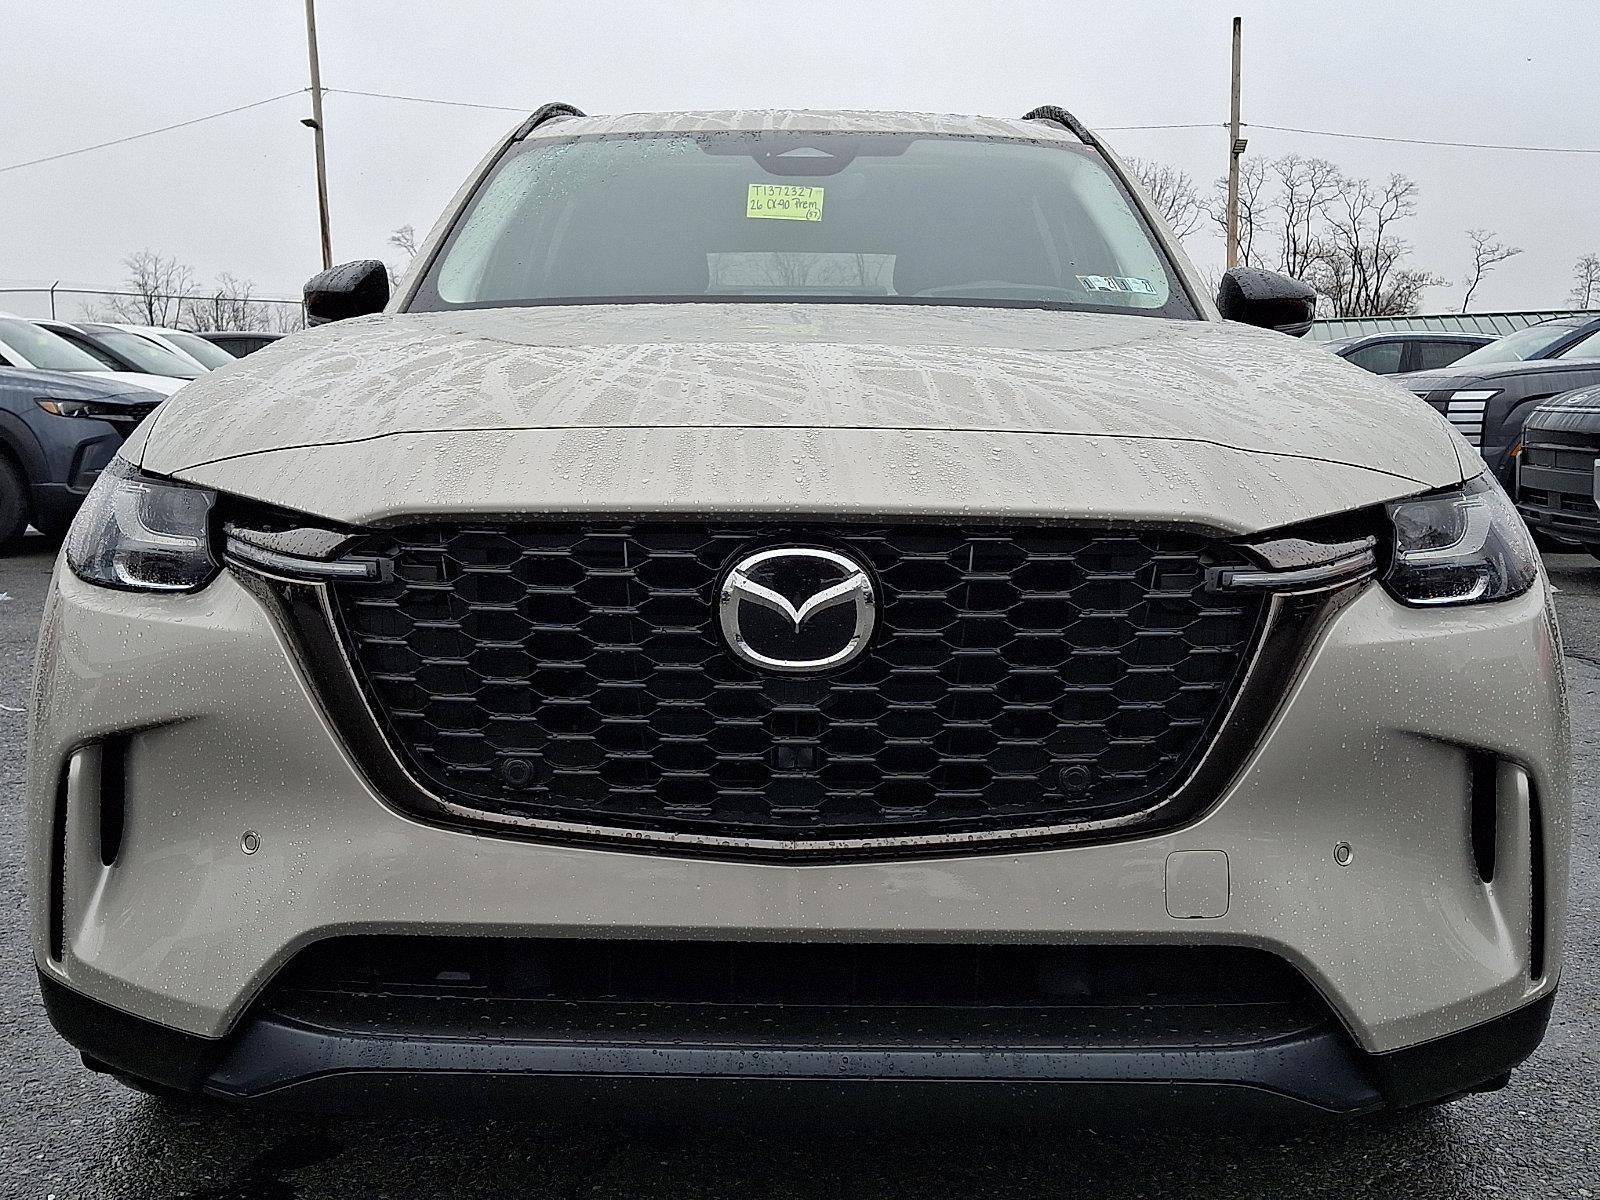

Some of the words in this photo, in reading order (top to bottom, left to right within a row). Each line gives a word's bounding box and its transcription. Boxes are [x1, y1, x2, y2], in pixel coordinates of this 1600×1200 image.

[752, 186, 813, 198] T1372327
[750, 199, 763, 210] 26
[792, 198, 817, 210] Prem
